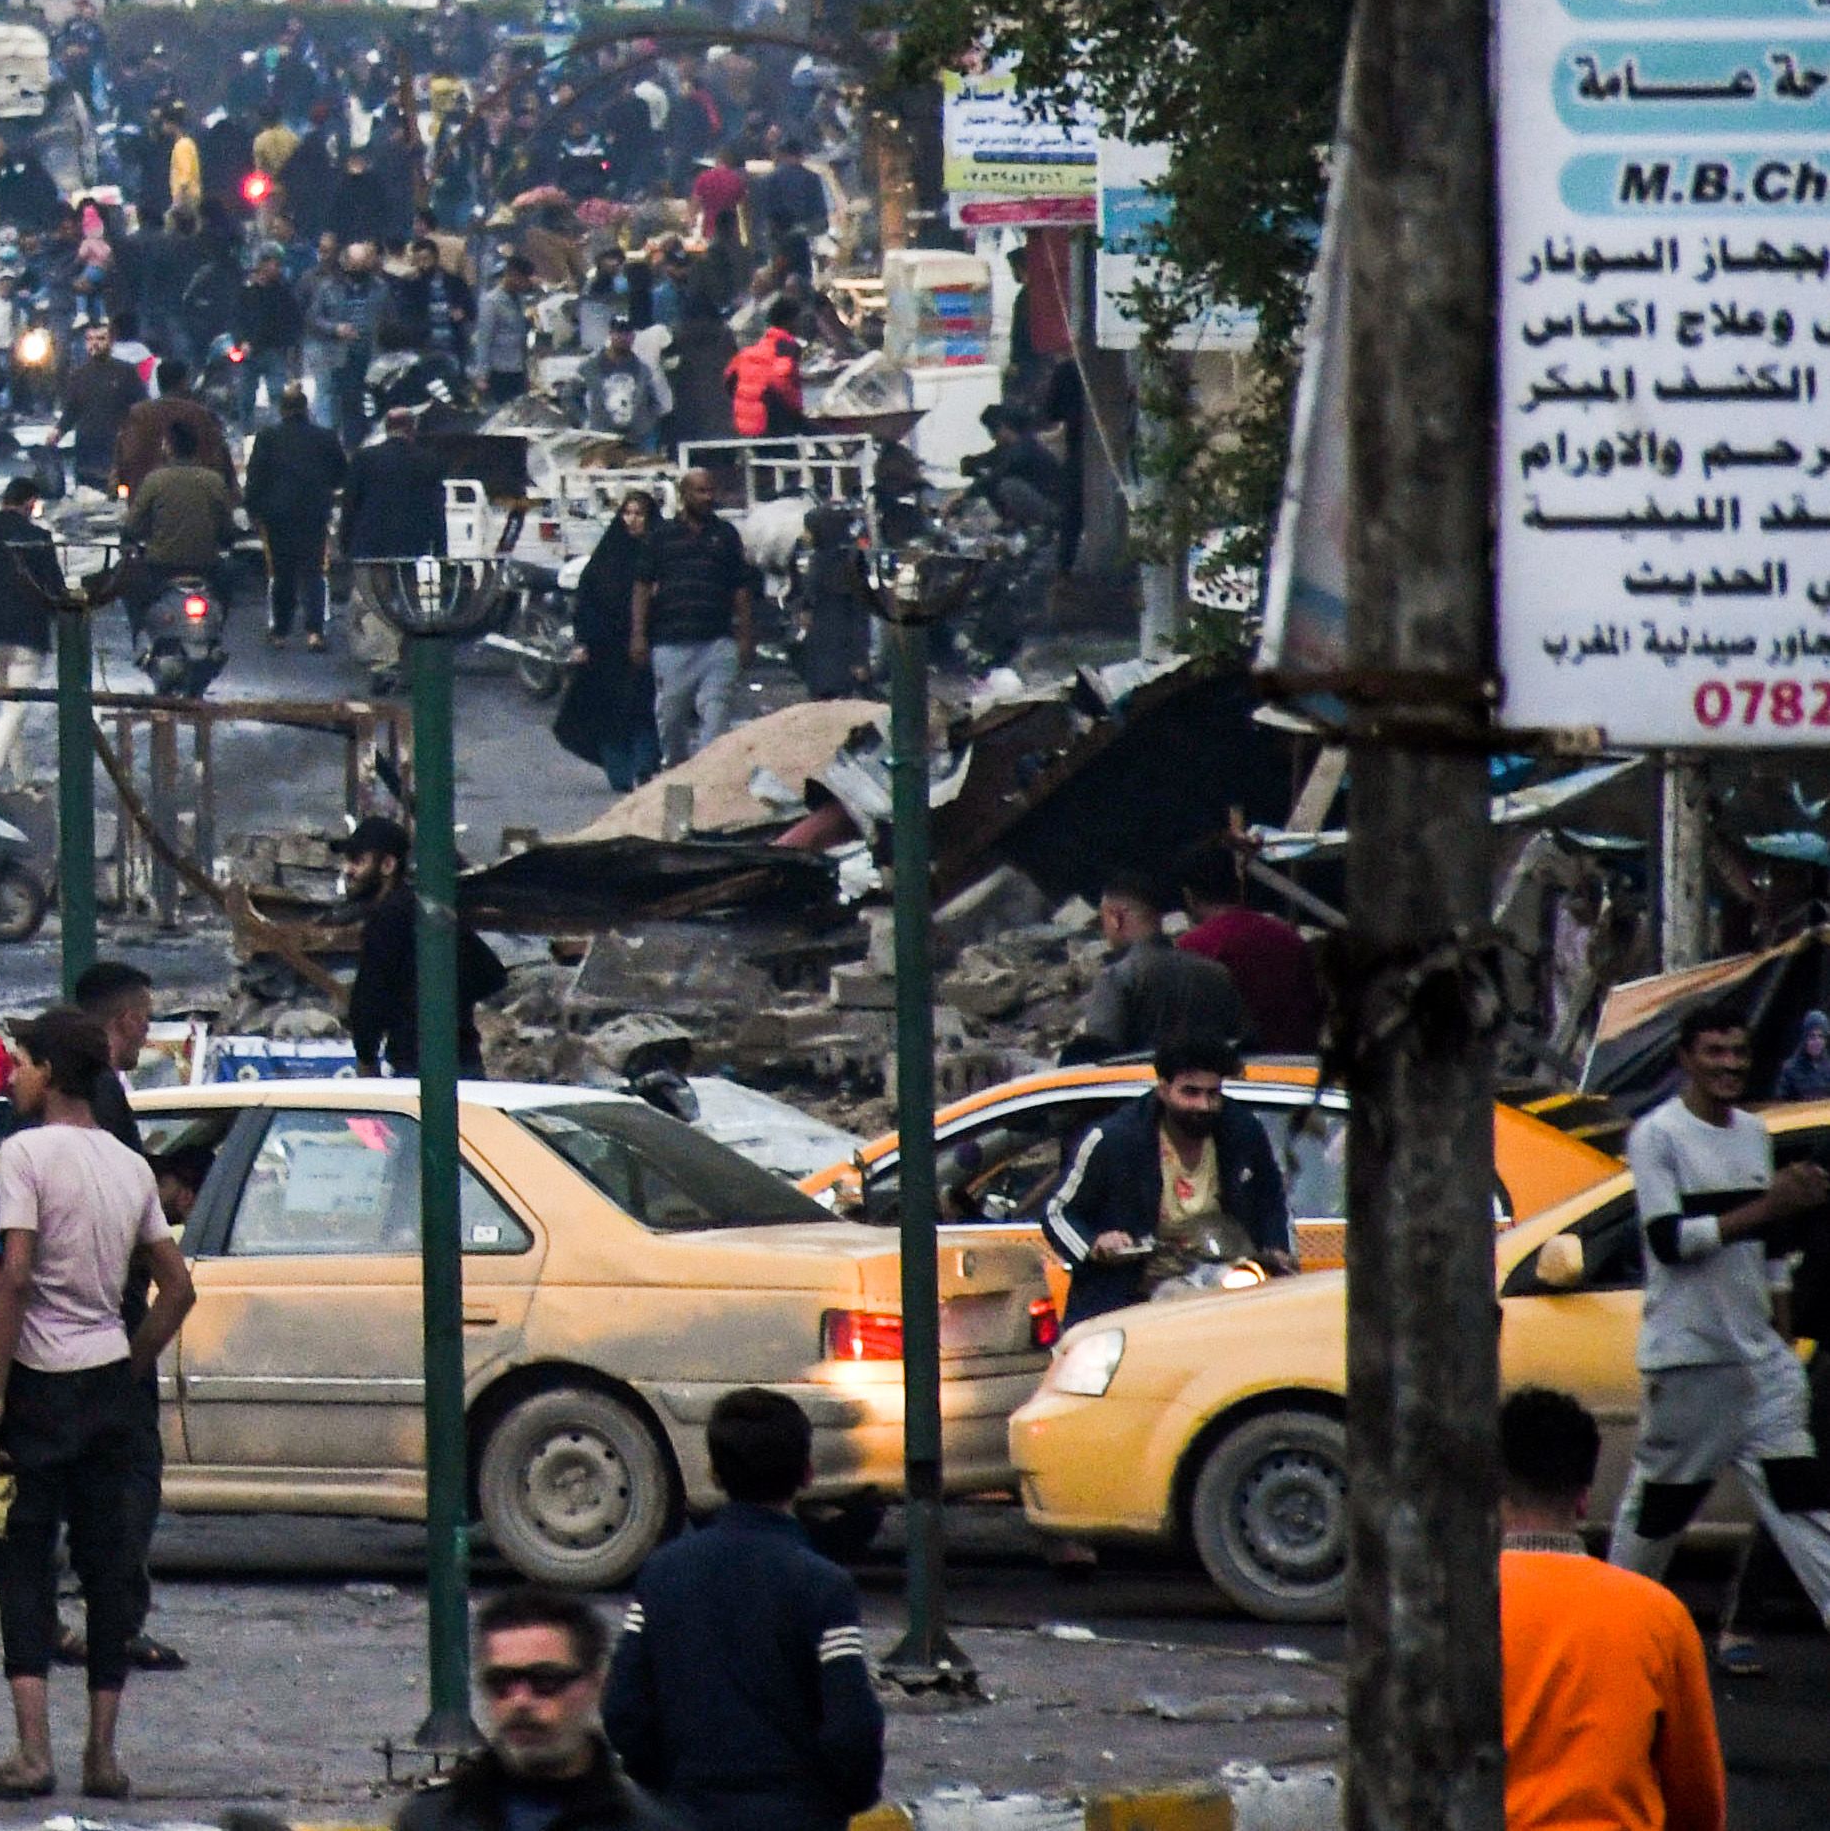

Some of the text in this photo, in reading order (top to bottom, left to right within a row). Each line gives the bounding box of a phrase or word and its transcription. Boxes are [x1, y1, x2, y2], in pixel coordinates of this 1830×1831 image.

[1518, 235, 1680, 283] السونار
[1675, 301, 1795, 347] وعلاج
[1519, 364, 1636, 413] المبكر
[1624, 560, 1788, 606] الحديث
[1643, 620, 1757, 668] صيدلية
